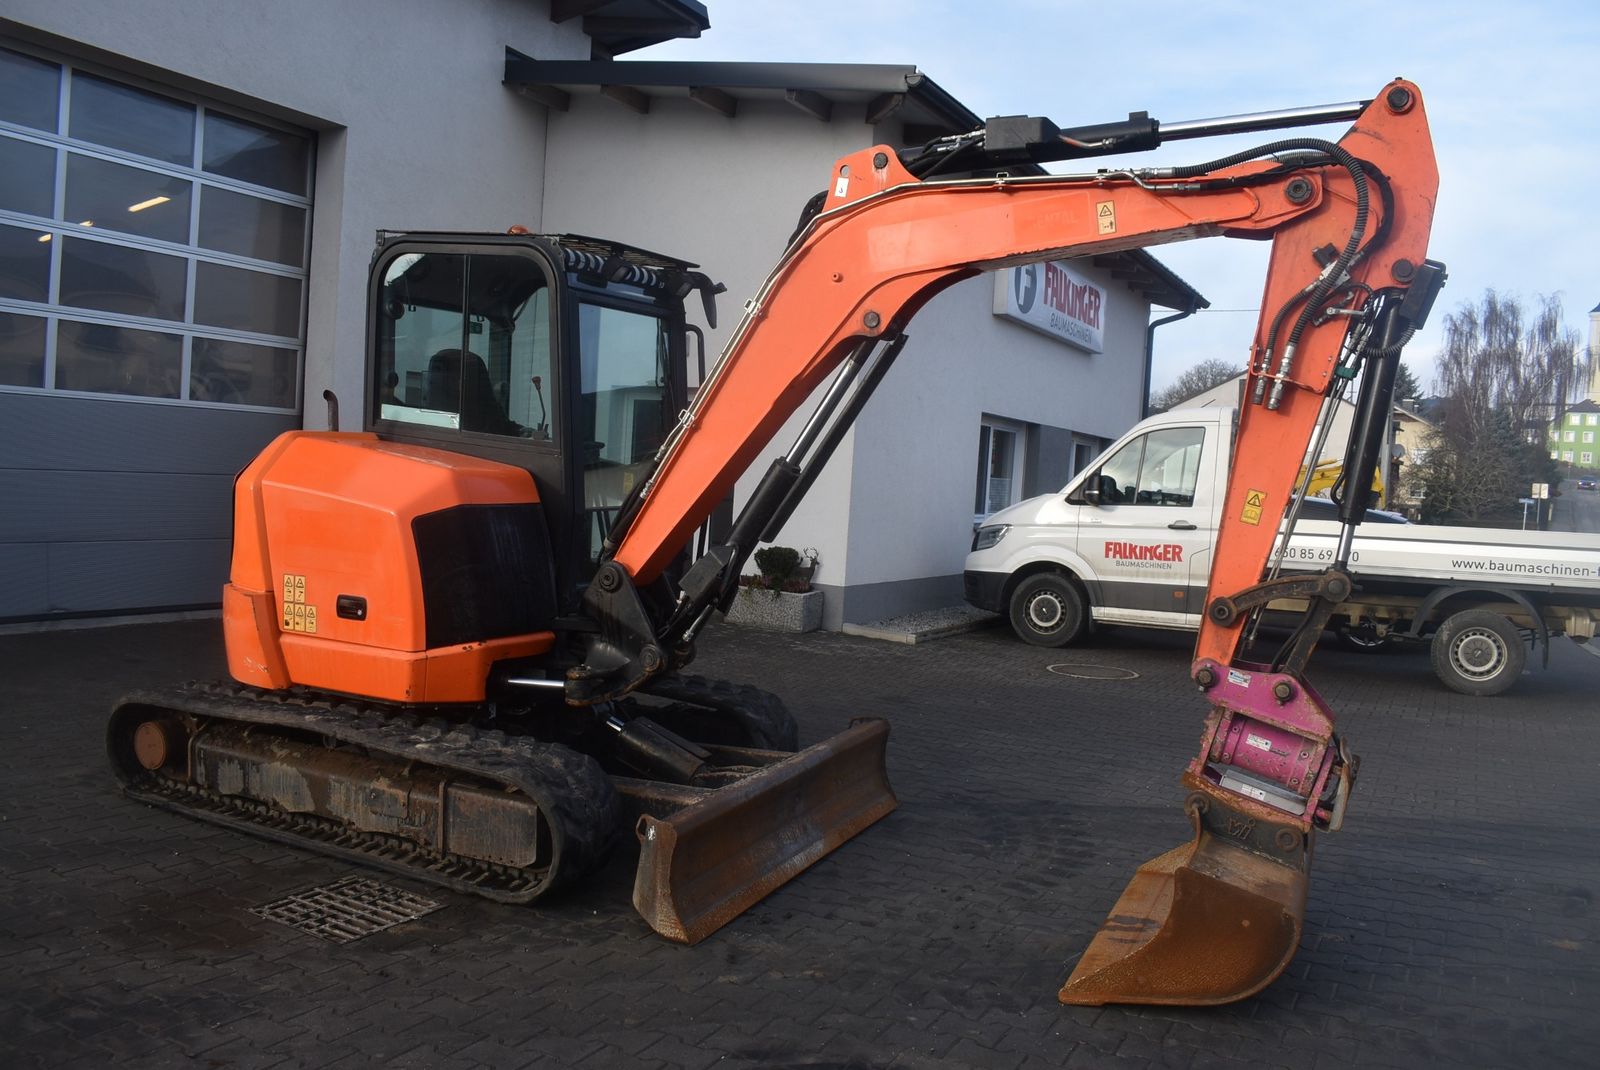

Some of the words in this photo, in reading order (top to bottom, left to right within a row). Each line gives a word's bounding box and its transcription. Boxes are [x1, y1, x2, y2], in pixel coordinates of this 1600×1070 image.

[1043, 262, 1101, 330] FALKINGER
[1050, 313, 1092, 345] BAUMASCHINEN
[1104, 541, 1183, 562] FALKINGER
[1300, 549, 1314, 560] 85
[1318, 549, 1333, 560] 69
[1115, 560, 1172, 569] BAUMASCHINEN
